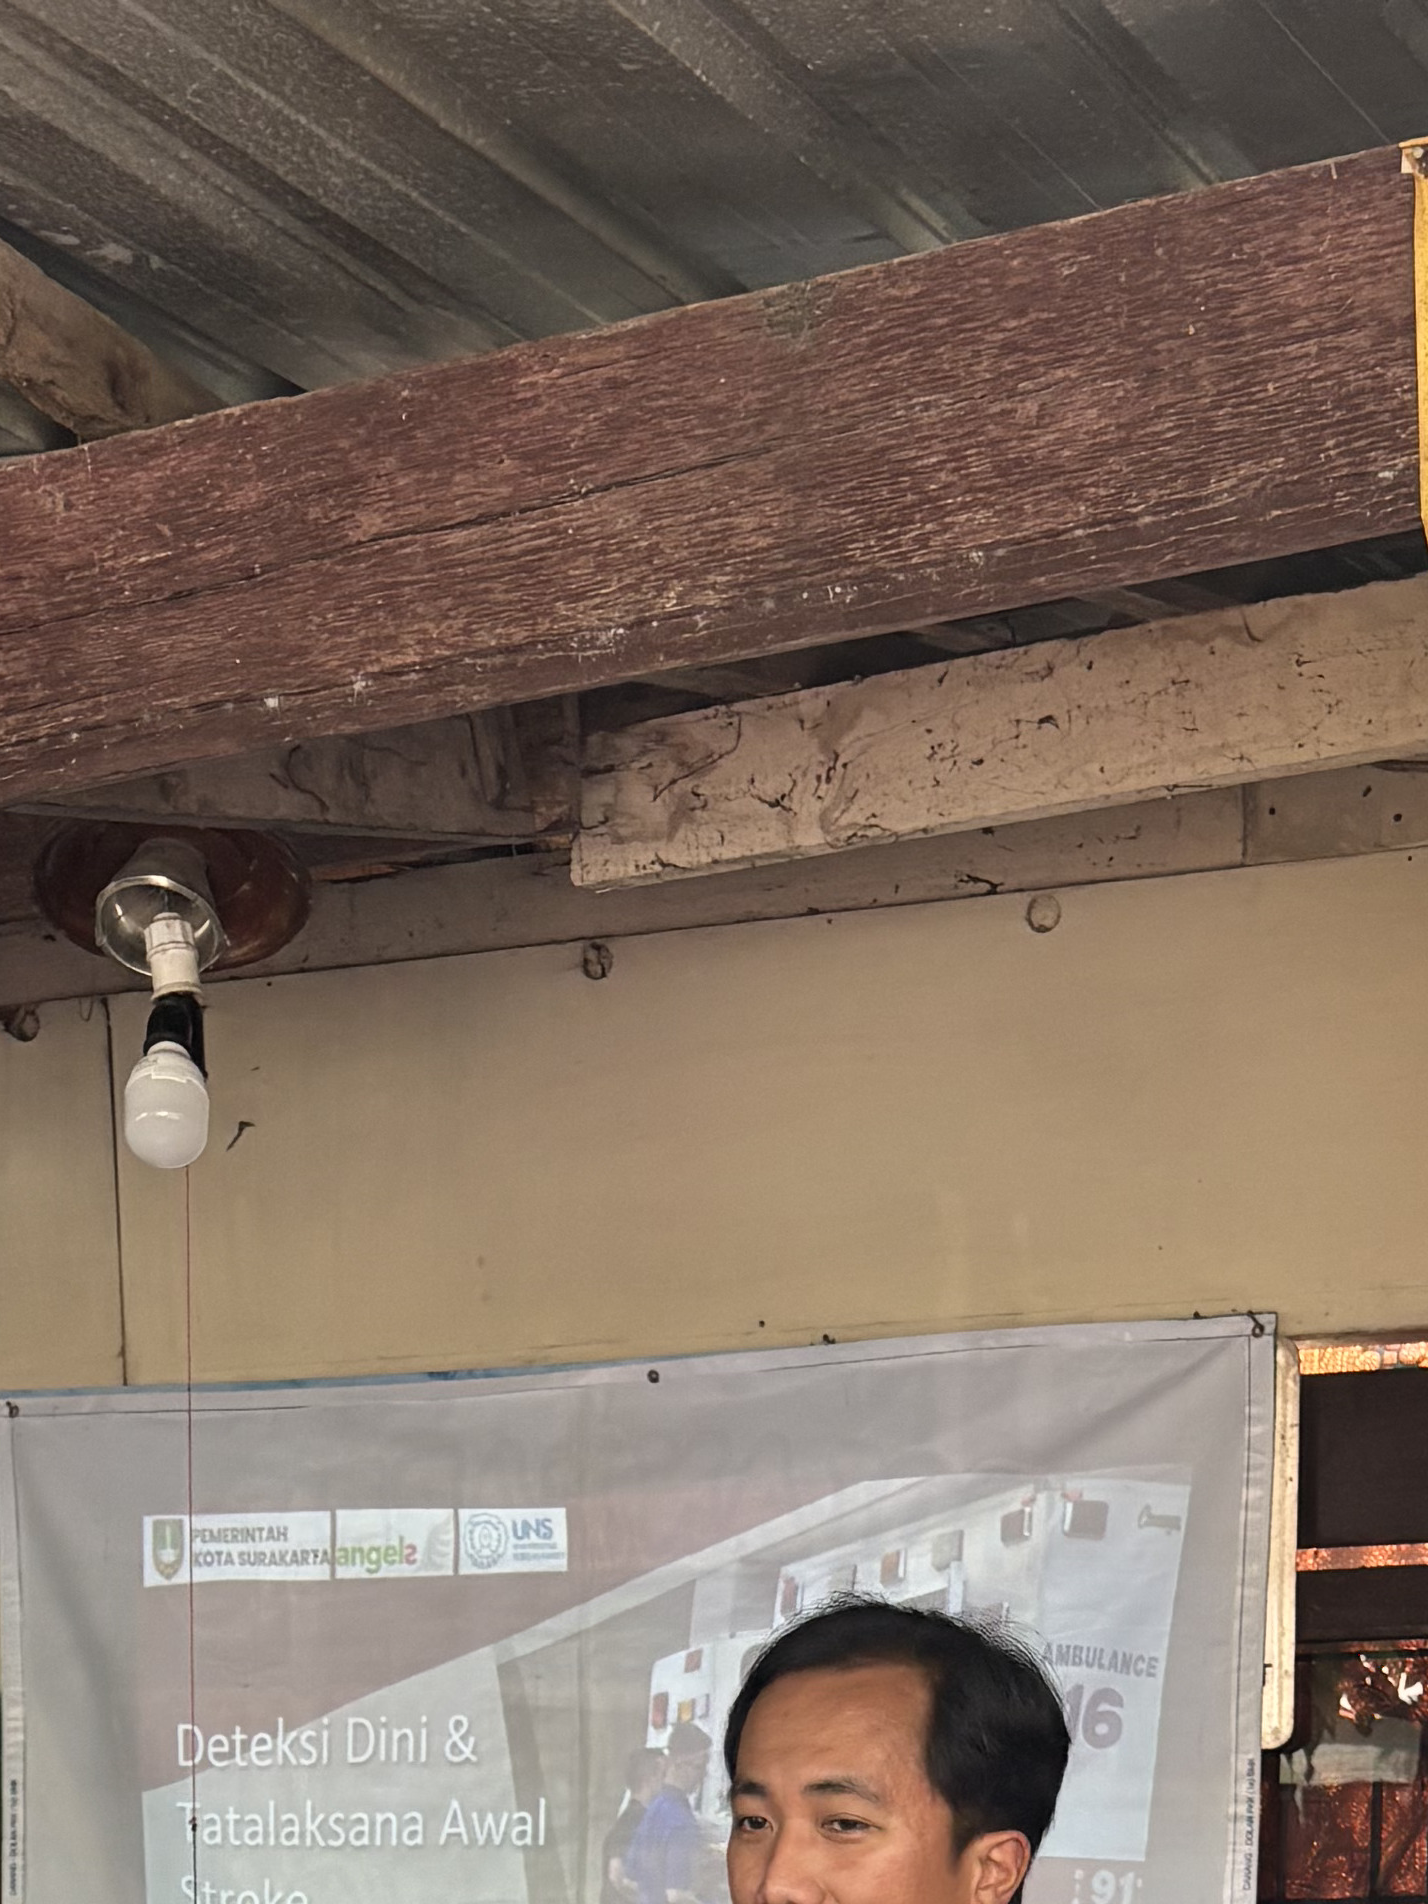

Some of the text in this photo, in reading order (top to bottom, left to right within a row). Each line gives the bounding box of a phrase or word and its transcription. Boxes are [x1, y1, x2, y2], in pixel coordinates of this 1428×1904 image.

[191, 1525, 289, 1544] PEMERINTAH
[512, 1518, 554, 1541] UNS
[194, 1549, 332, 1568] KOTA SURAKARTA
[1044, 1642, 1160, 1679] AMBULANCE
[176, 1714, 479, 1768] Deteksi Dini &
[175, 1797, 547, 1848] Tatalaksana Awal
